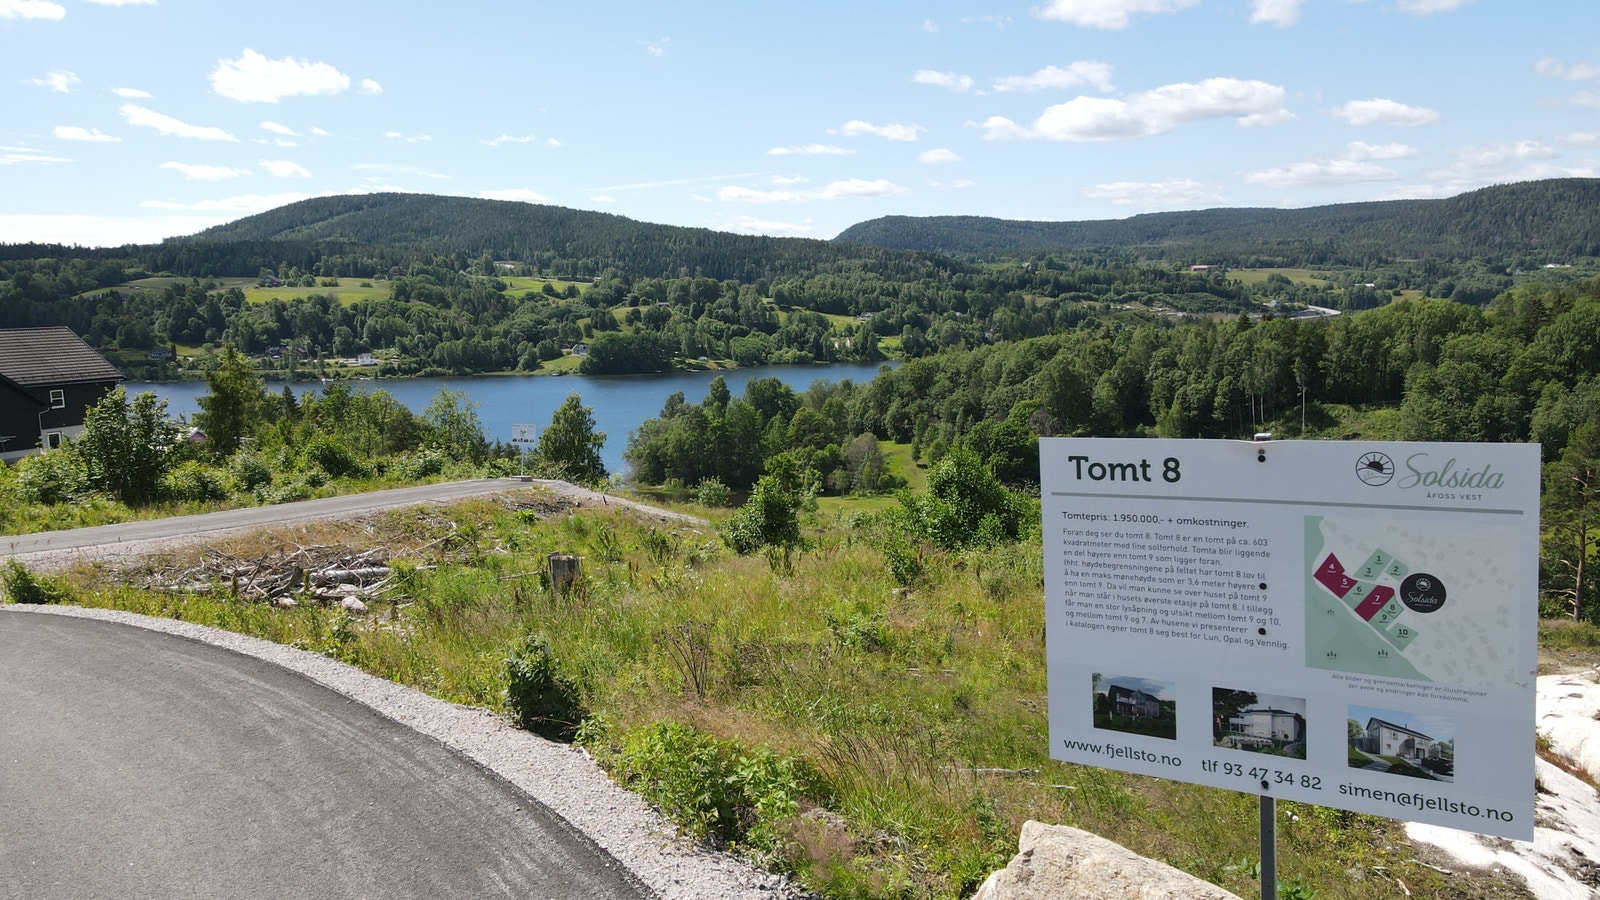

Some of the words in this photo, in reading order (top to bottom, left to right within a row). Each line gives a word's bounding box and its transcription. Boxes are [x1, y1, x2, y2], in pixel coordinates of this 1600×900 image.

[1068, 456, 1151, 482] Tomt
[1162, 457, 1180, 482] 8
[1398, 453, 1505, 489] Solsida
[1062, 511, 1109, 521] Tomtepris:
[1114, 514, 1163, 524] 1.950.000,-
[1176, 517, 1248, 529] omkostninger.
[1085, 530, 1098, 538] deg
[1226, 536, 1236, 545] på
[1063, 539, 1111, 547] kvadratmeter
[1148, 544, 1189, 552] solforhold.
[1192, 546, 1216, 554] Tomta
[1235, 549, 1270, 558] liggende
[1087, 550, 1111, 558] høyere
[1174, 556, 1196, 565] ligger
[1082, 560, 1162, 573] høydebegrensningene
[1165, 565, 1174, 574] på
[1113, 574, 1156, 582] mønehøyde
[1228, 581, 1255, 590] høyere
[1148, 586, 1171, 594] kunne
[1228, 592, 1238, 600] på
[1117, 594, 1142, 602] husets
[1174, 599, 1197, 608] etasje
[1200, 600, 1208, 608] på
[1247, 605, 1272, 615] tillegg
[1122, 604, 1157, 615] lysåpning
[1270, 617, 1280, 626] 10,
[1070, 620, 1104, 630] katalogen
[1204, 633, 1220, 642] Lun,
[1223, 635, 1241, 644] Opal
[1256, 638, 1289, 650] Vennlig.
[1161, 619, 1189, 627] husene
[1200, 624, 1247, 633] presenterer
[1399, 629, 1408, 637] 10
[1064, 739, 1182, 767] www.fjellsto.no
[1202, 760, 1218, 772] tlf
[1224, 762, 1243, 777] 93
[1248, 767, 1268, 780] 47
[1274, 770, 1294, 785] 34
[1300, 775, 1322, 790] 82
[1339, 783, 1514, 822] simen@fjellsto.no
